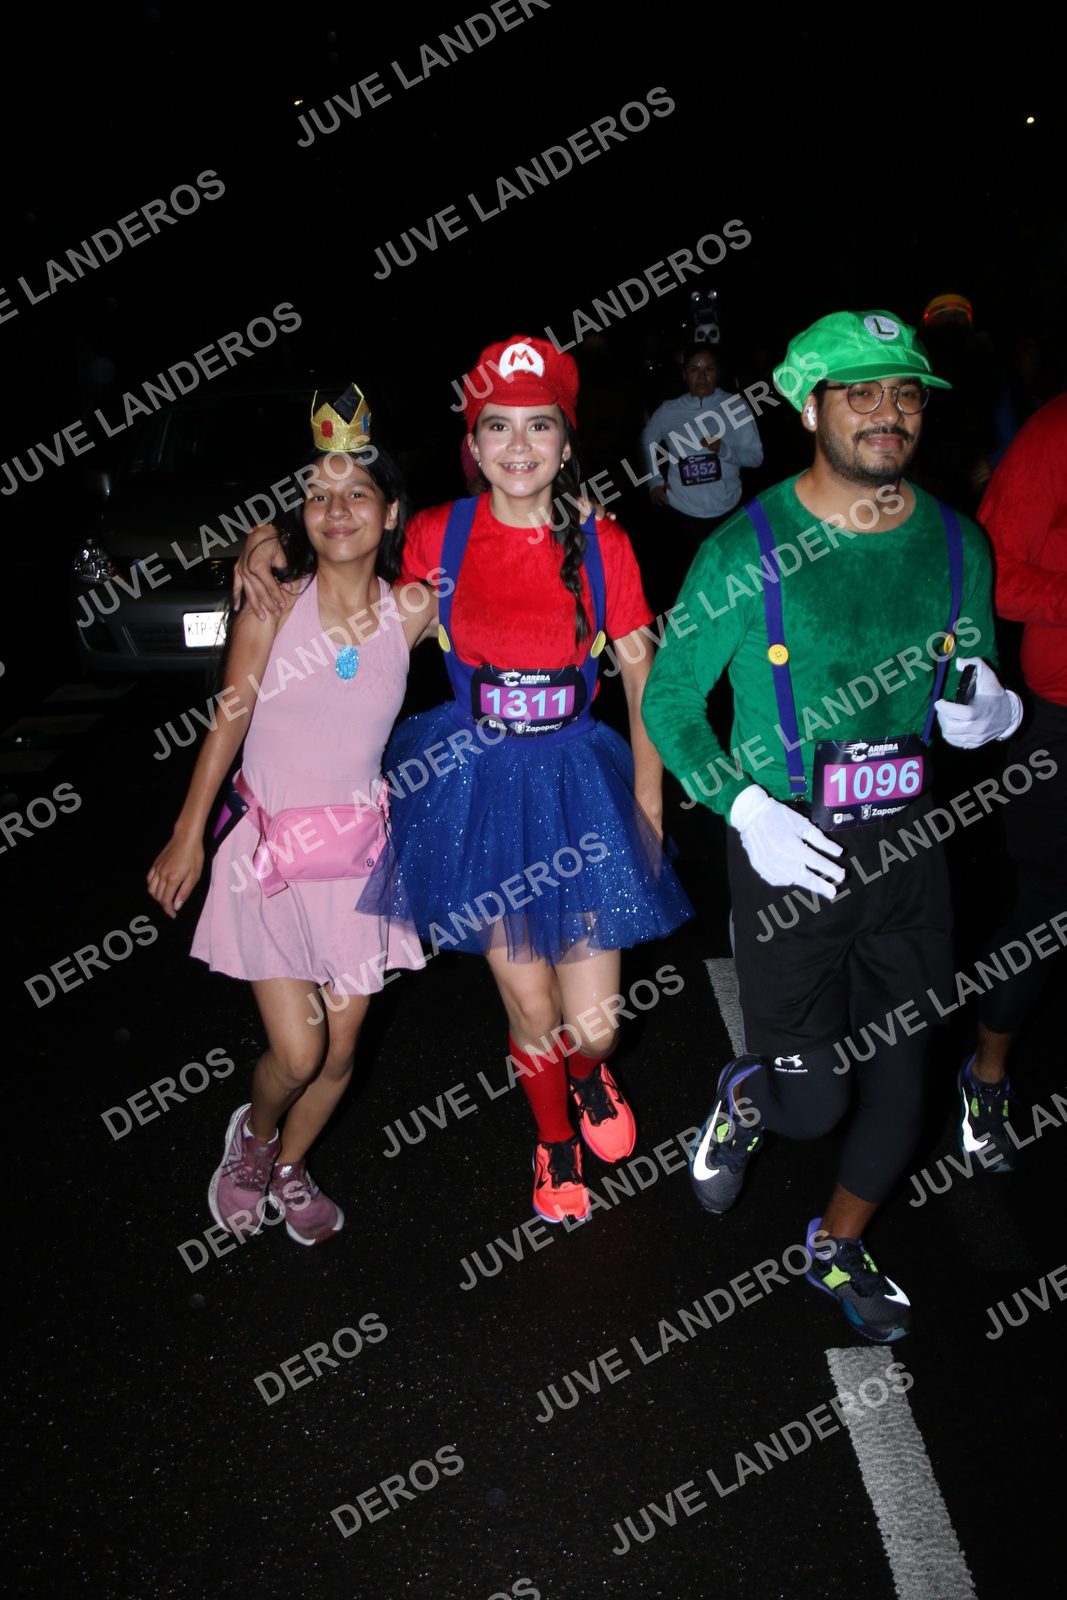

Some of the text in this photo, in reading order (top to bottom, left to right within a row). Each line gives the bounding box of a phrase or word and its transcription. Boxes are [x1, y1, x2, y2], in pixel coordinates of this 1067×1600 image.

[873, 317, 895, 335] L
[508, 350, 534, 366] M
[683, 461, 717, 478] 1352
[486, 688, 567, 718] 1311
[830, 760, 920, 803] 1096
